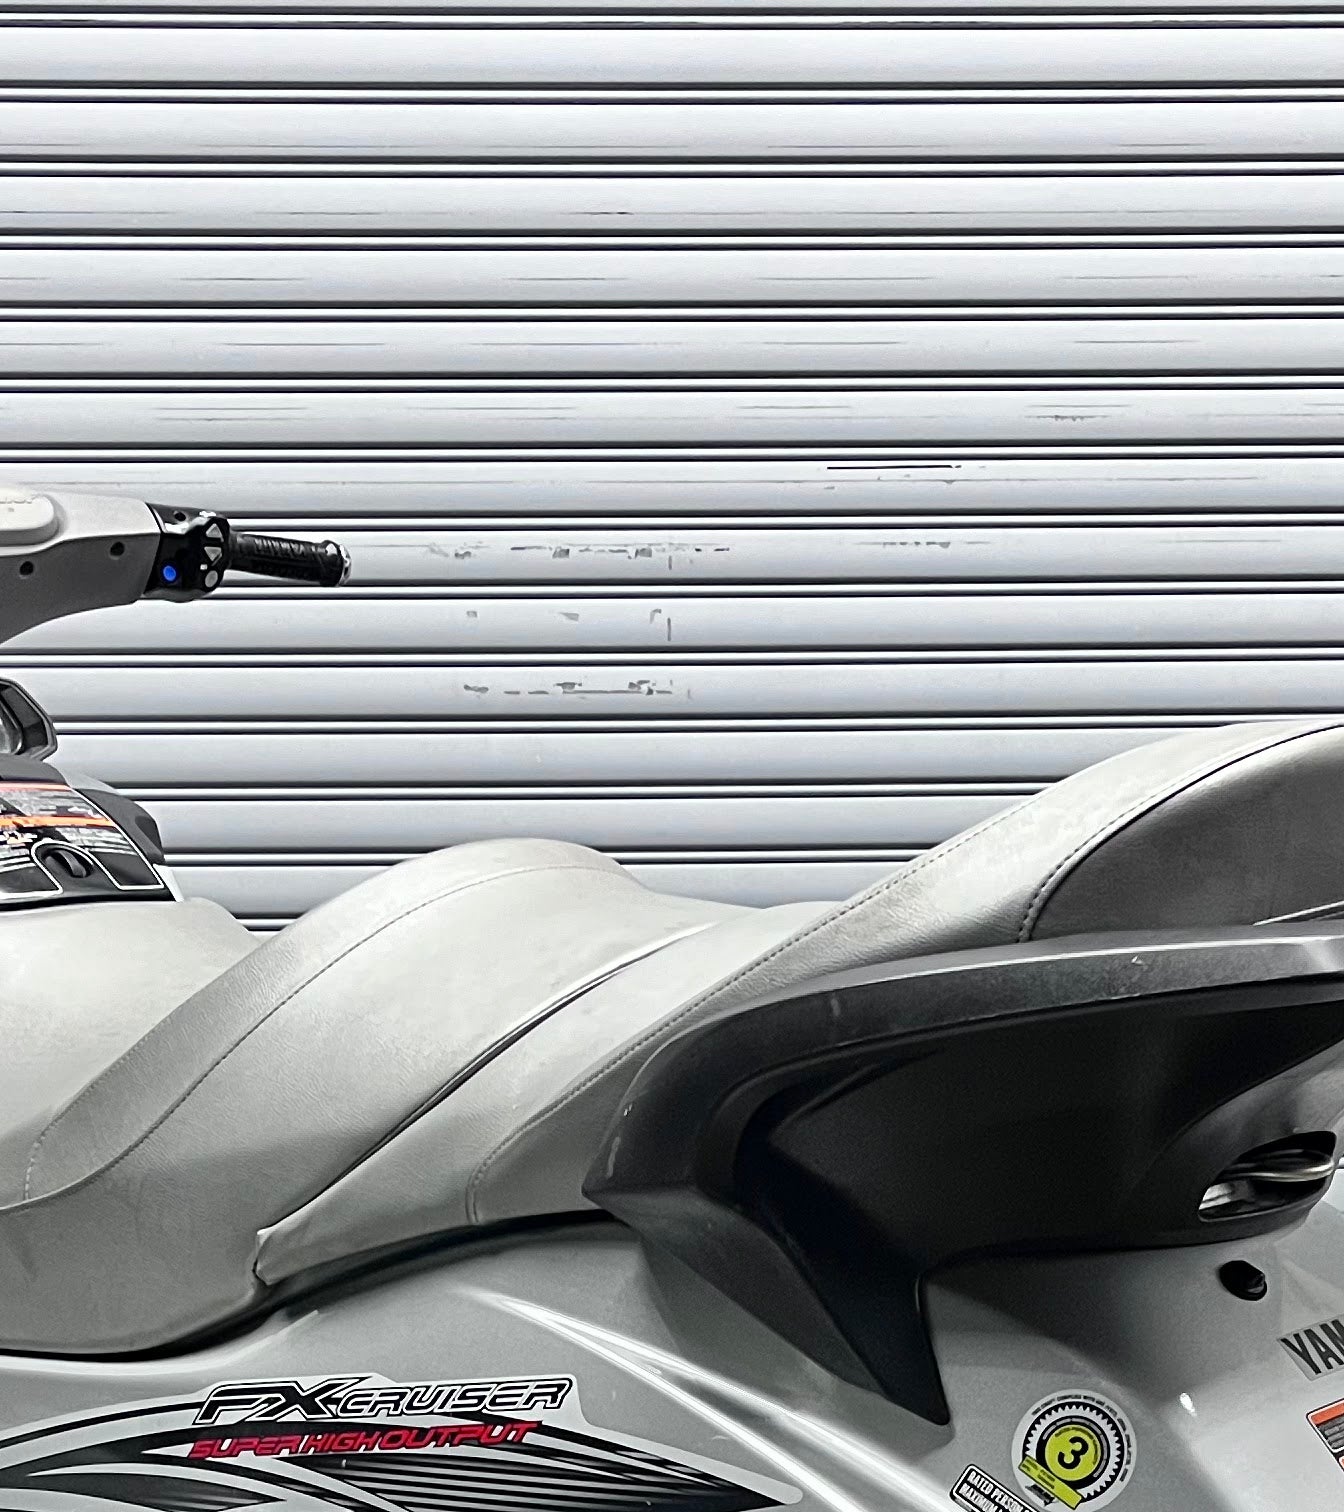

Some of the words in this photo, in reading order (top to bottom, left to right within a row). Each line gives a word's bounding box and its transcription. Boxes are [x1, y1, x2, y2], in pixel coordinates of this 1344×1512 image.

[192, 1375, 373, 1426] FX
[336, 1378, 573, 1419] CRUISER
[187, 1435, 303, 1461] SUPER
[302, 1429, 381, 1456] HIGH
[378, 1420, 544, 1450] OUTPUT
[1057, 1435, 1089, 1470] 3
[967, 1470, 994, 1496] RATED
